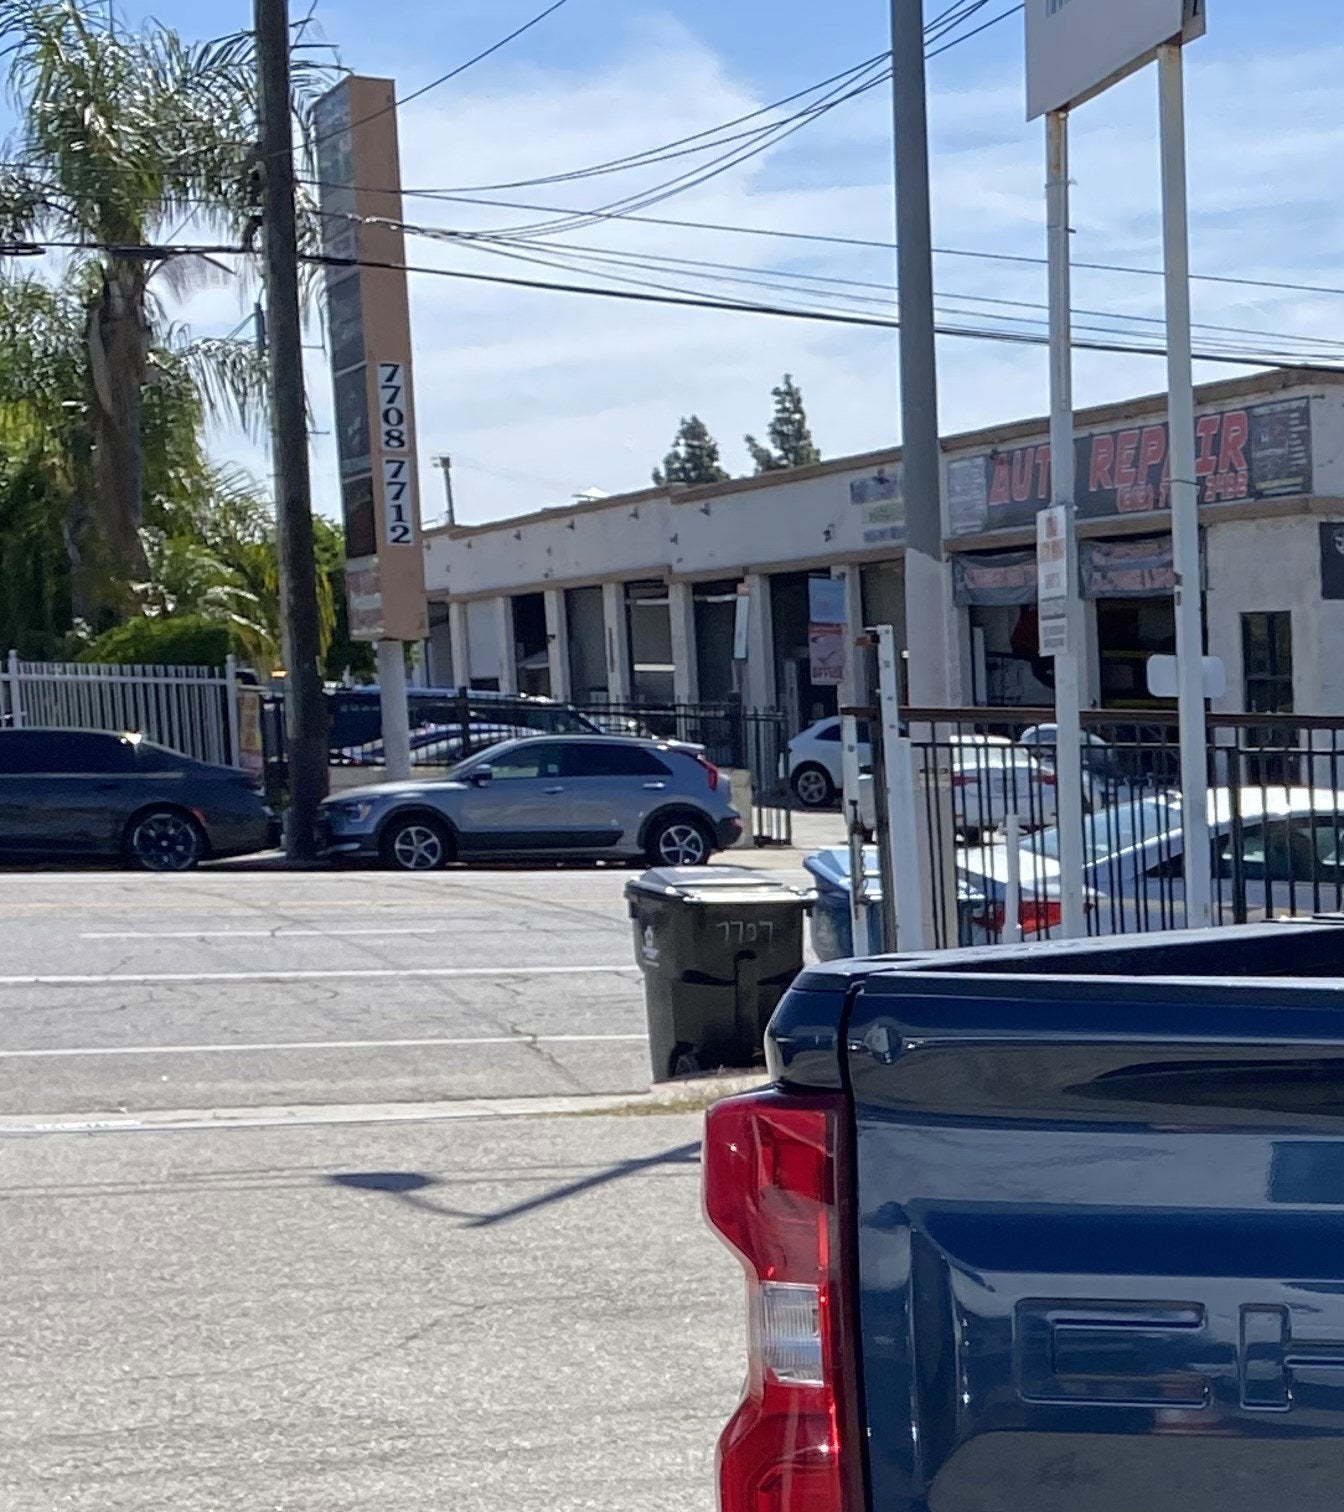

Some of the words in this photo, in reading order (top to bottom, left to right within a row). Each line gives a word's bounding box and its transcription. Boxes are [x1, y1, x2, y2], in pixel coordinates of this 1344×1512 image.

[379, 362, 406, 450] 7708
[384, 458, 411, 545] 7712
[988, 445, 1054, 506] AUT
[1088, 409, 1250, 492] REPIR
